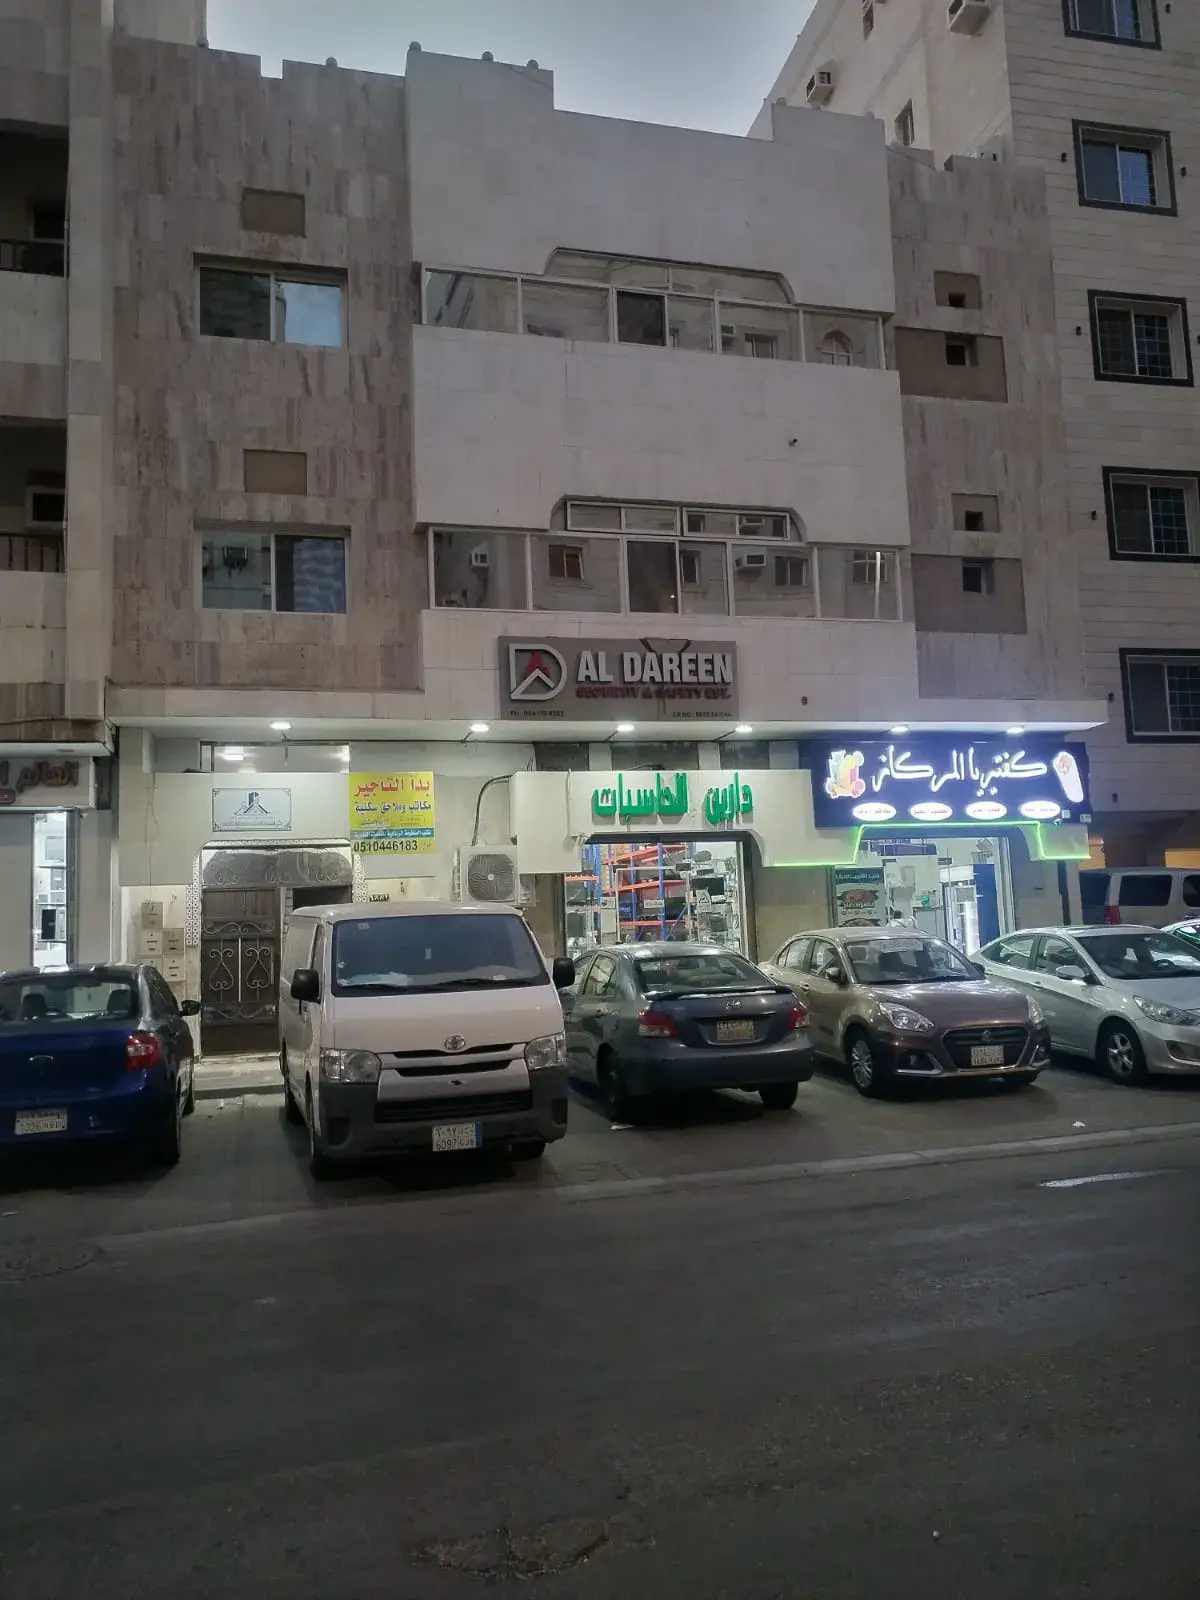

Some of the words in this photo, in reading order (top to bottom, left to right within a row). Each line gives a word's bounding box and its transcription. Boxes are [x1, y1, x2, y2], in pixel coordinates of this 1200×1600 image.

[577, 650, 614, 683] AL
[623, 652, 733, 684] DAREEN
[655, 687, 703, 700] SAFETY
[16, 759, 80, 793] العالم
[705, 772, 753, 825] دارين
[355, 801, 378, 814] سكنية
[381, 801, 405, 814] وملاحق
[408, 801, 431, 813] مكاتب
[353, 840, 418, 852] 0510446183
